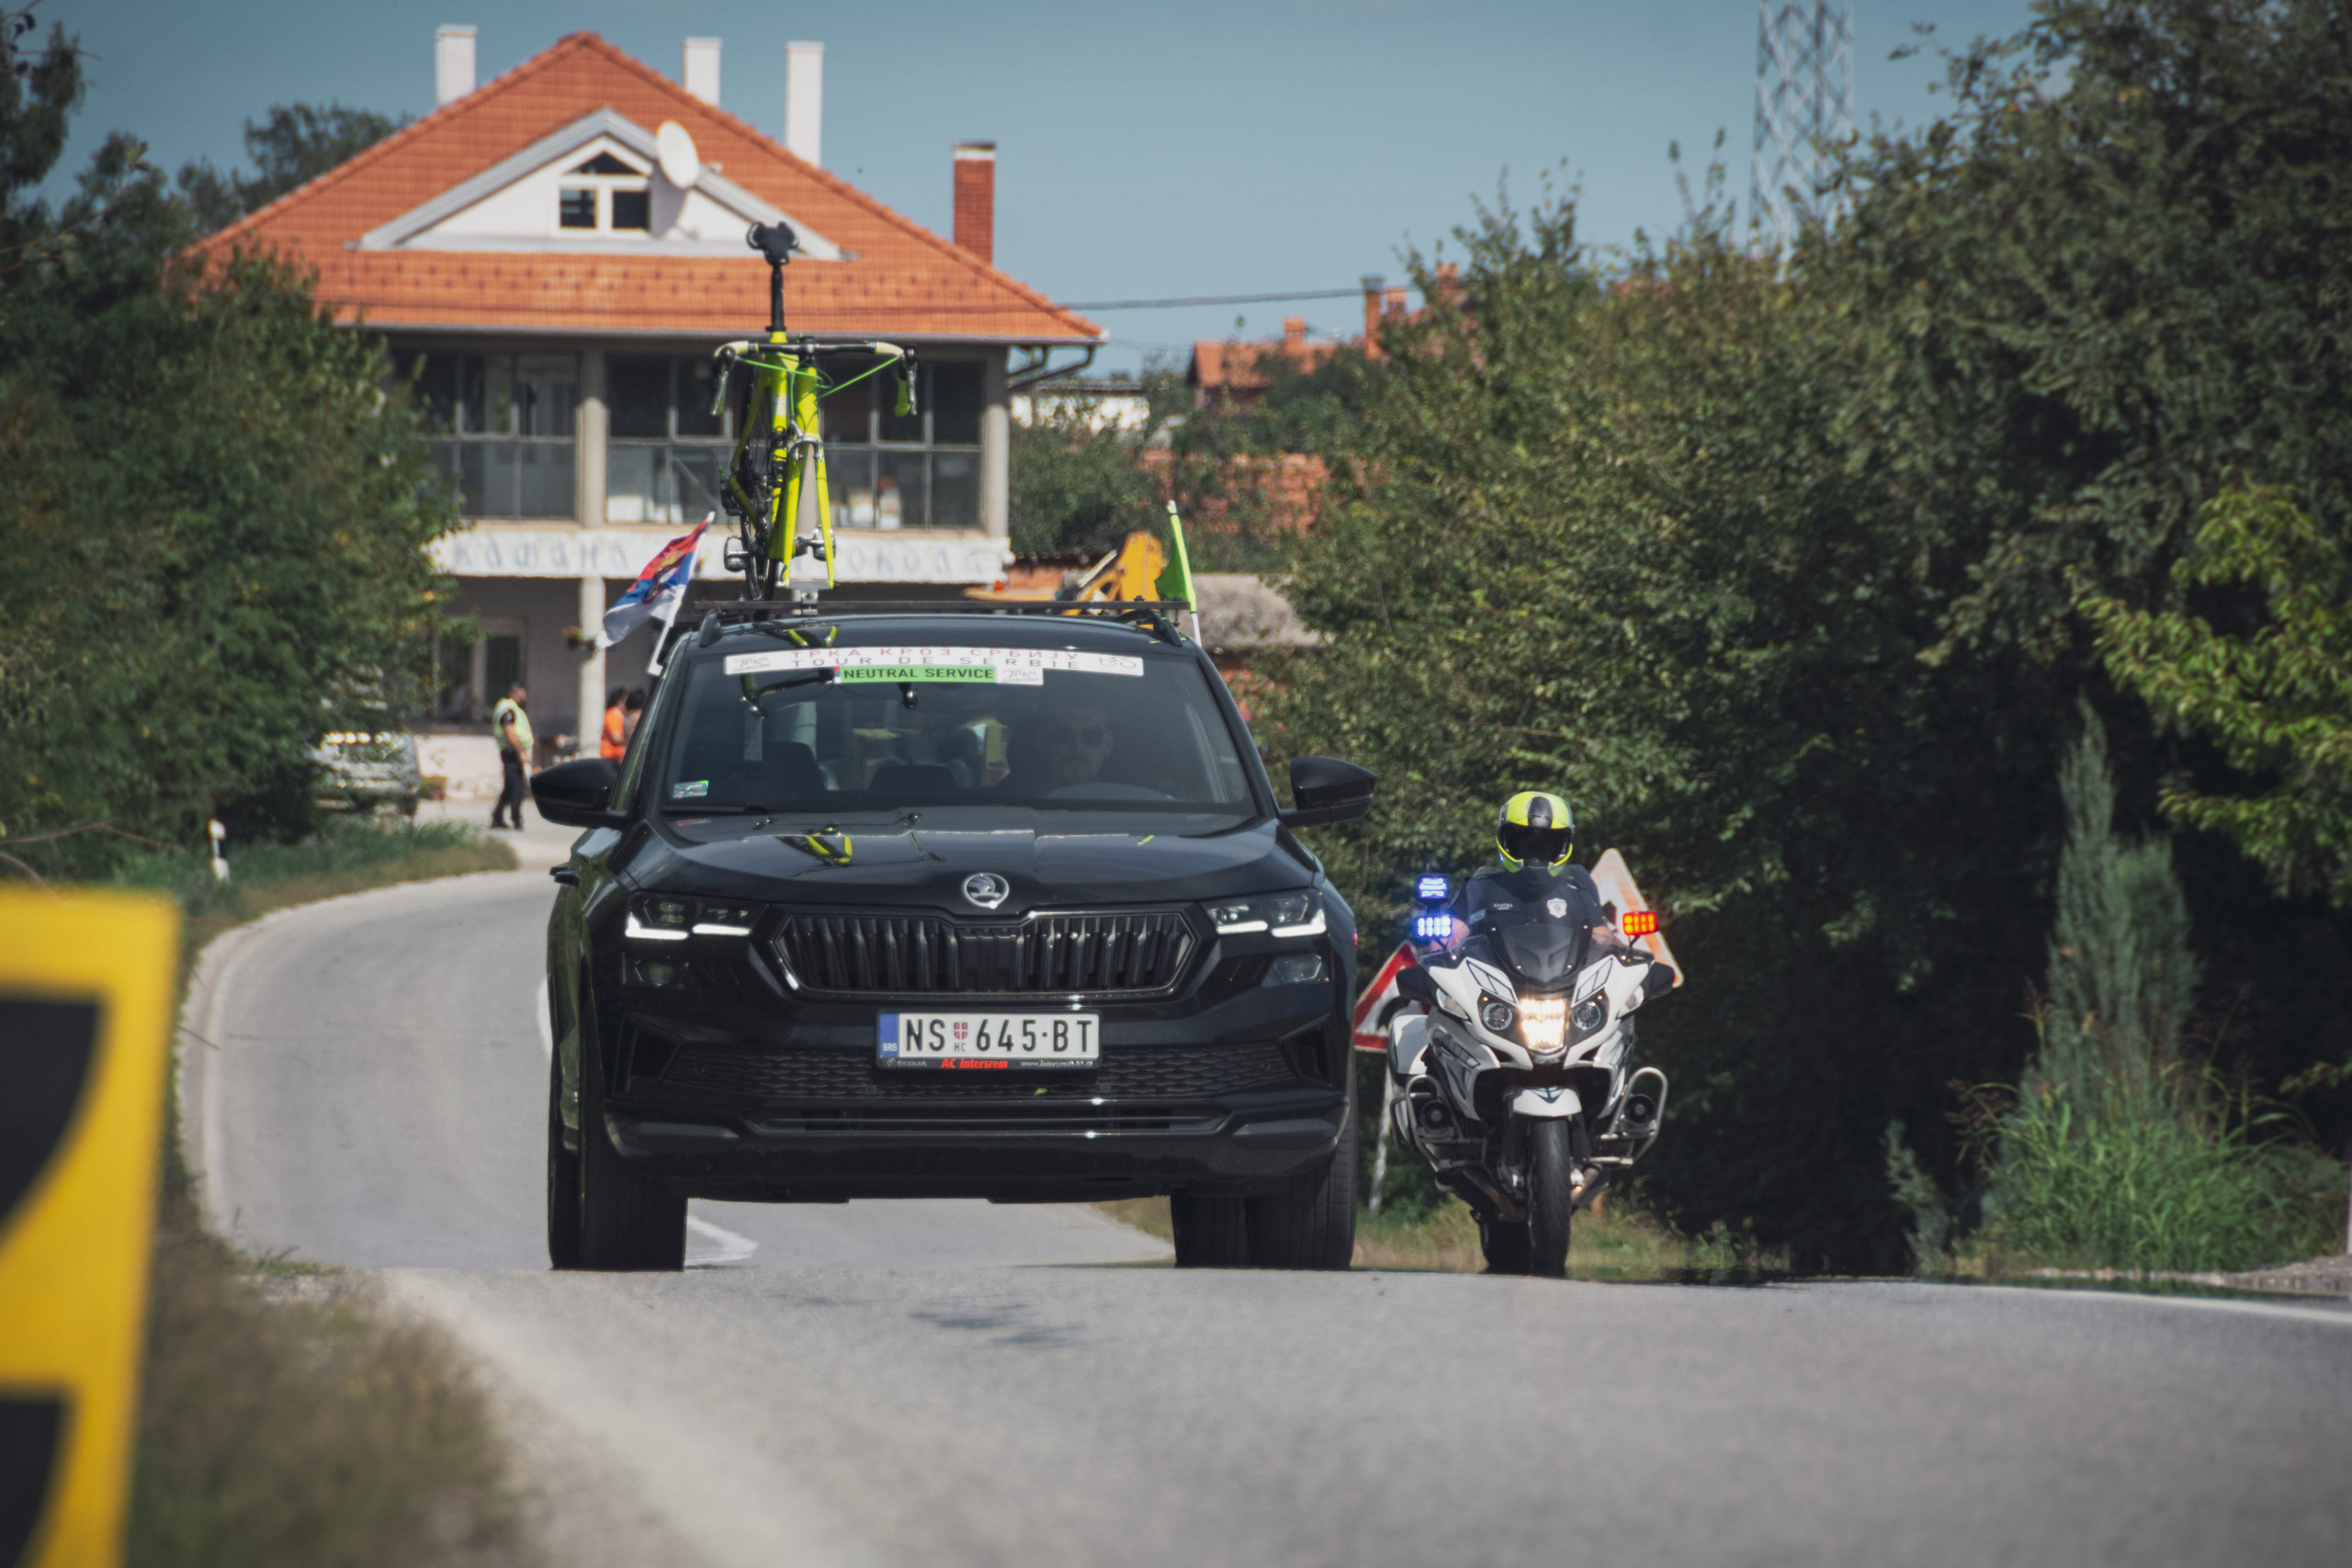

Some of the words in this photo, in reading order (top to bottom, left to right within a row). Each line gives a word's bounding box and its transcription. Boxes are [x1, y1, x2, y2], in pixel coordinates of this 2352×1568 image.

[791, 649, 861, 659] ТРКА
[880, 648, 951, 656] КРОЗ
[970, 649, 1079, 660] СРБИЈУ
[791, 658, 872, 667] TOUR
[899, 656, 934, 665] DE
[959, 656, 1080, 670] SERBIE
[843, 668, 919, 679] NEUTRAL
[924, 668, 994, 679] SERVICE
[906, 1019, 945, 1052] NS
[882, 1043, 898, 1052] SRB
[940, 1058, 956, 1069] AC
[959, 1058, 1008, 1069] Intersrem
